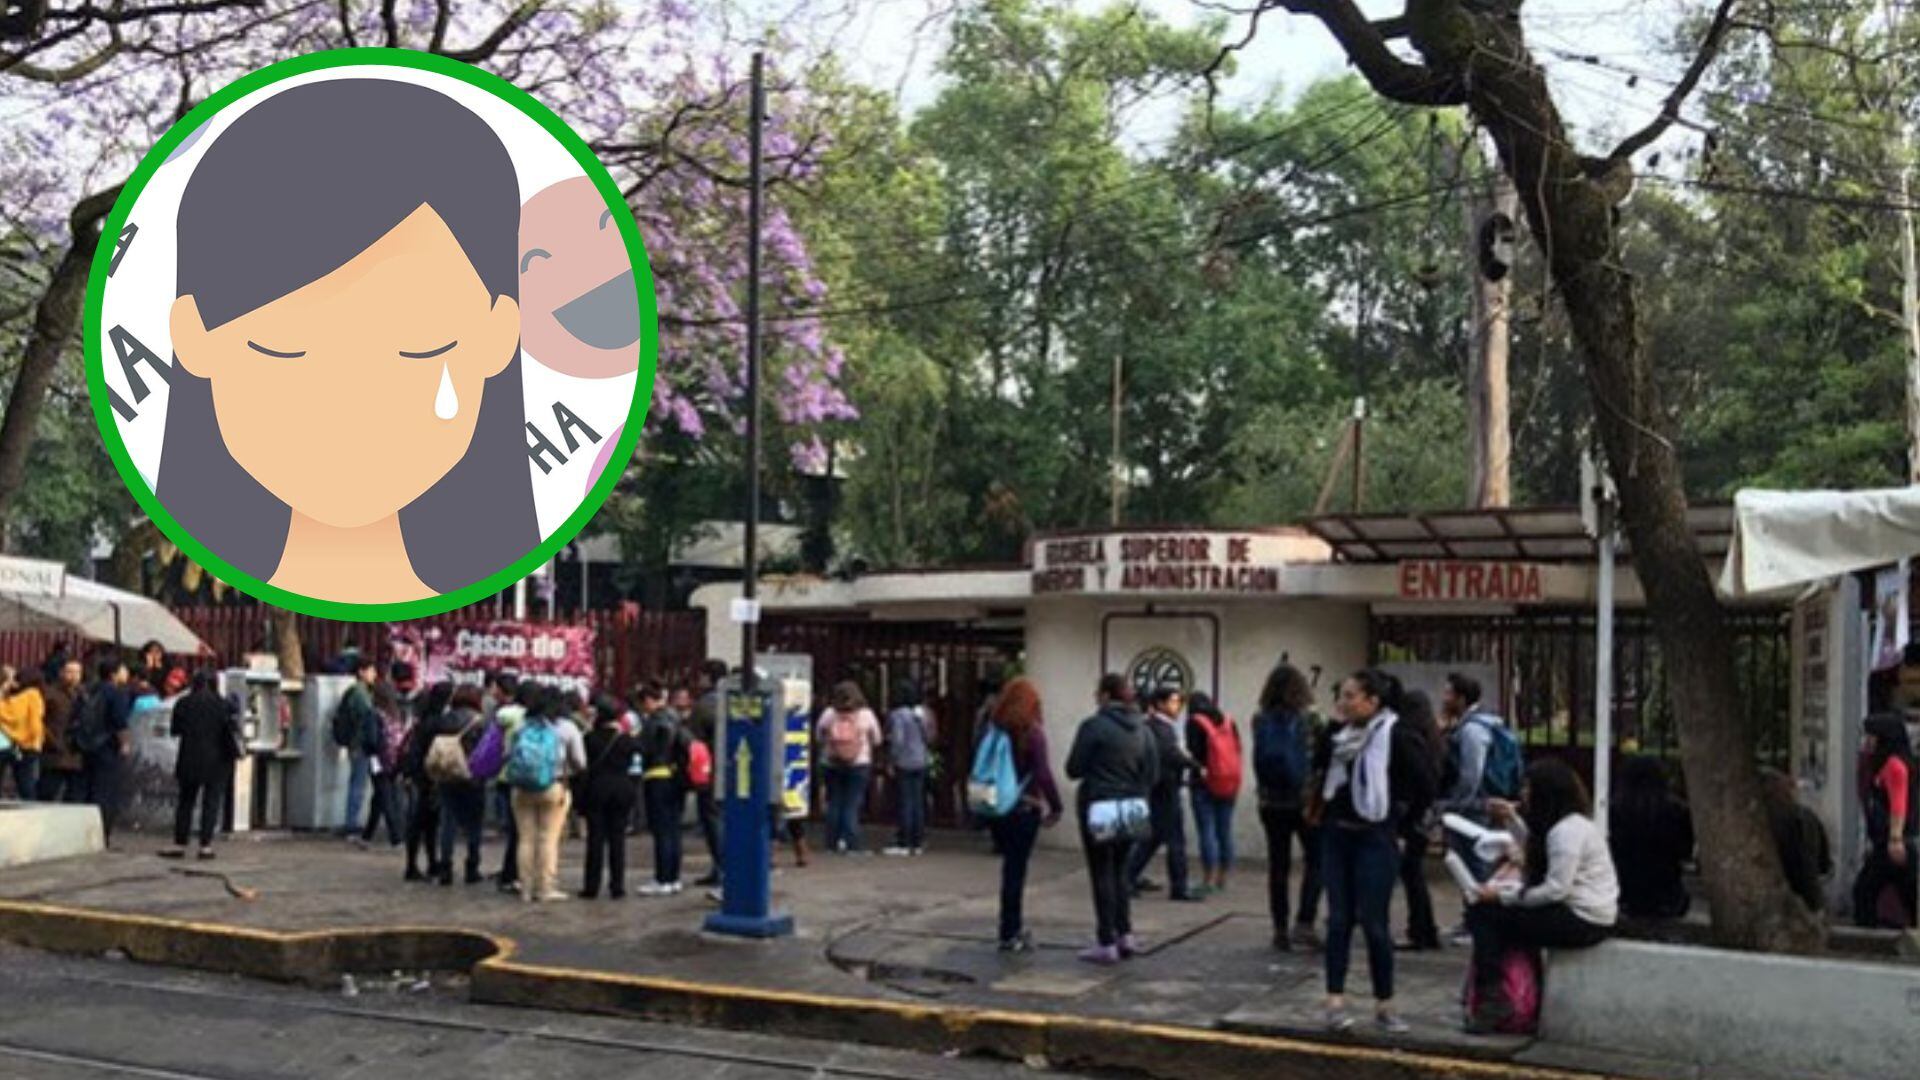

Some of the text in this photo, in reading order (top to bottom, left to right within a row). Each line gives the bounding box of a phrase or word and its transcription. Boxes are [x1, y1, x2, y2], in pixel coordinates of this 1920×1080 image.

[1120, 536, 1210, 562] SUPERIOR
[1227, 537, 1250, 562] DE
[1097, 567, 1108, 590] Y
[1121, 565, 1280, 591] ADMINISTRACION
[1400, 563, 1542, 599] ENTRADA
[532, 632, 568, 660] de
